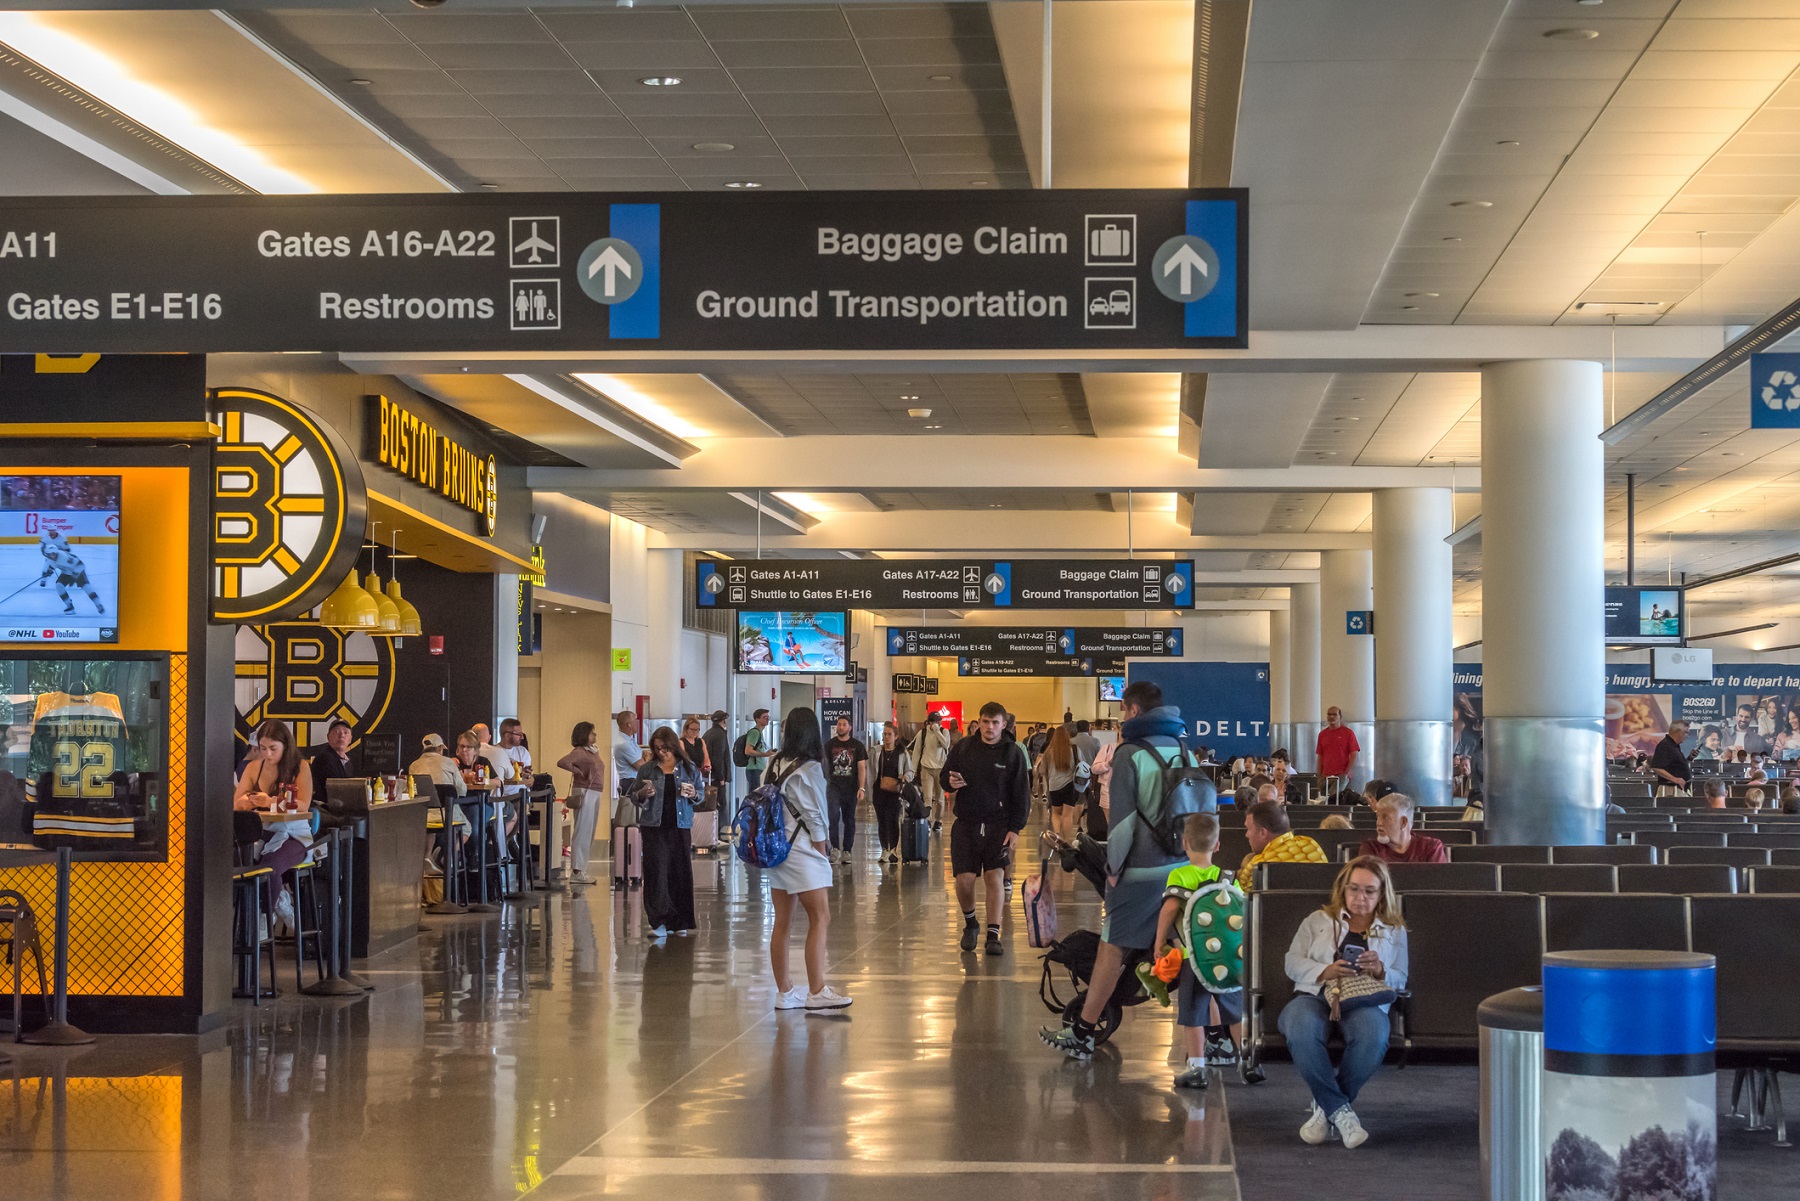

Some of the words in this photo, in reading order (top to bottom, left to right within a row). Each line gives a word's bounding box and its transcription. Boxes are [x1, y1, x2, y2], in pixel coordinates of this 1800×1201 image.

[0, 232, 55, 257] A11
[258, 230, 350, 257] Gates
[361, 230, 495, 257] A16-A22
[818, 228, 963, 261] Baggage
[974, 227, 1067, 254] Claim
[8, 293, 99, 320] Gates
[111, 293, 221, 319] E1-E16
[320, 293, 494, 319] Restrooms
[696, 290, 817, 318] Ground
[829, 290, 1067, 324] Transportation
[380, 395, 437, 489] BOSTON
[443, 436, 484, 513] BRUINS
[751, 570, 780, 579] Gates
[783, 571, 818, 579] A1-A11
[883, 570, 913, 579] Gates
[916, 571, 959, 579] A17-A22
[1060, 570, 1106, 581] Baggage
[1109, 570, 1138, 579] Claim
[751, 590, 786, 598] Shuttle
[803, 590, 832, 598] Gates
[836, 590, 871, 598] E1-E16
[903, 590, 958, 598] Restrooms
[1022, 590, 1060, 598] Ground
[1064, 590, 1138, 600] Transportation
[56, 630, 80, 638] YouTube
[1453, 673, 1482, 687] ining
[1728, 675, 1740, 686] to
[1743, 675, 1782, 689] depart
[1785, 676, 1800, 689] ha
[1683, 697, 1716, 706] BOS2GO
[53, 741, 115, 798] 22
